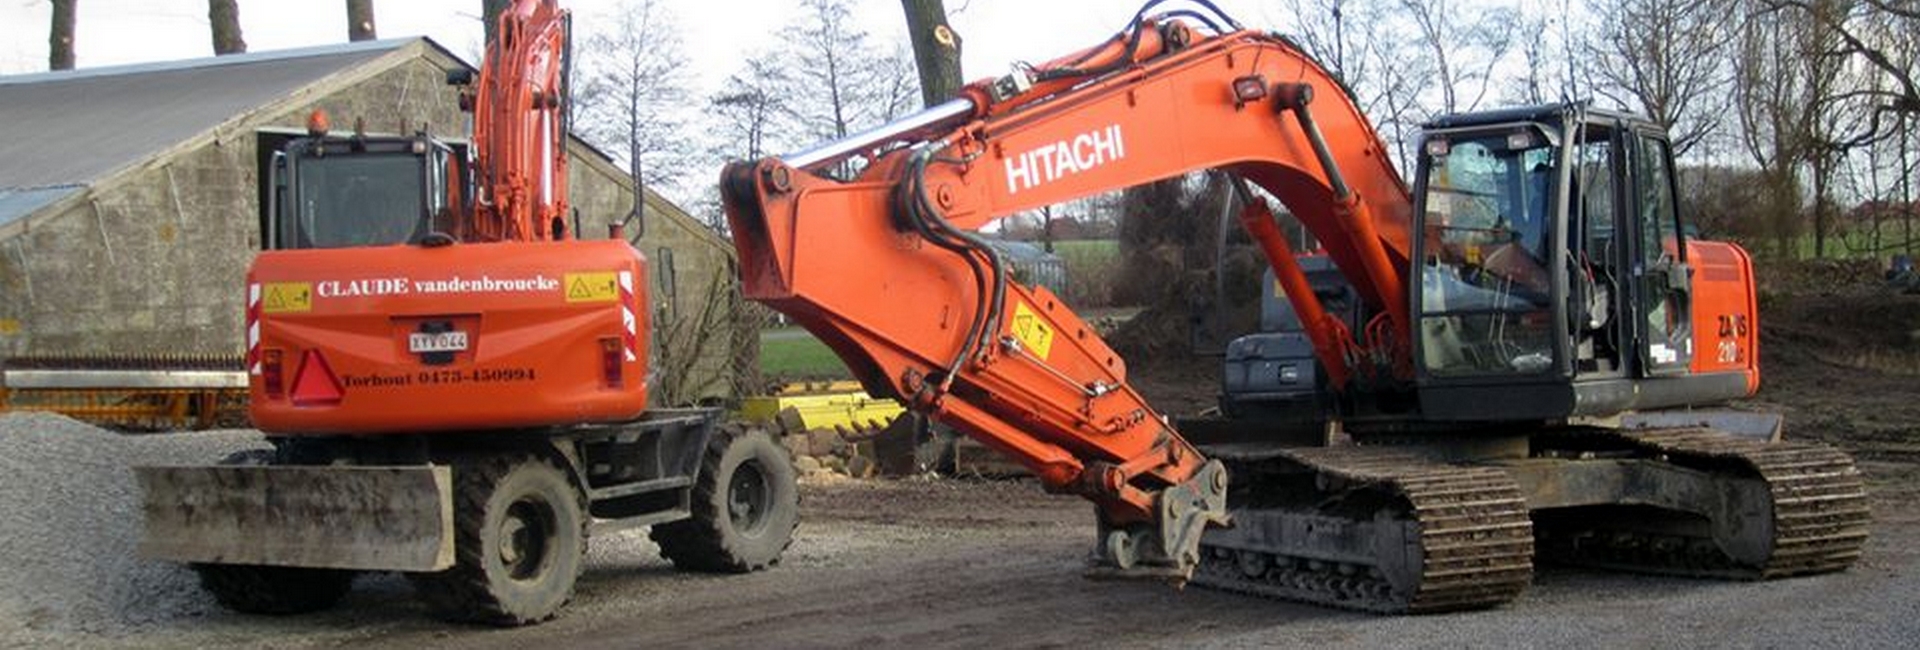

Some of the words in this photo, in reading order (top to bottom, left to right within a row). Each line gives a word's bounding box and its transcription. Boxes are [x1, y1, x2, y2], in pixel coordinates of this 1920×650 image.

[1004, 124, 1125, 194] HITACHI
[317, 278, 409, 297] CLAUDE
[414, 275, 560, 293] vandenbroucke
[343, 374, 411, 387] Torhout
